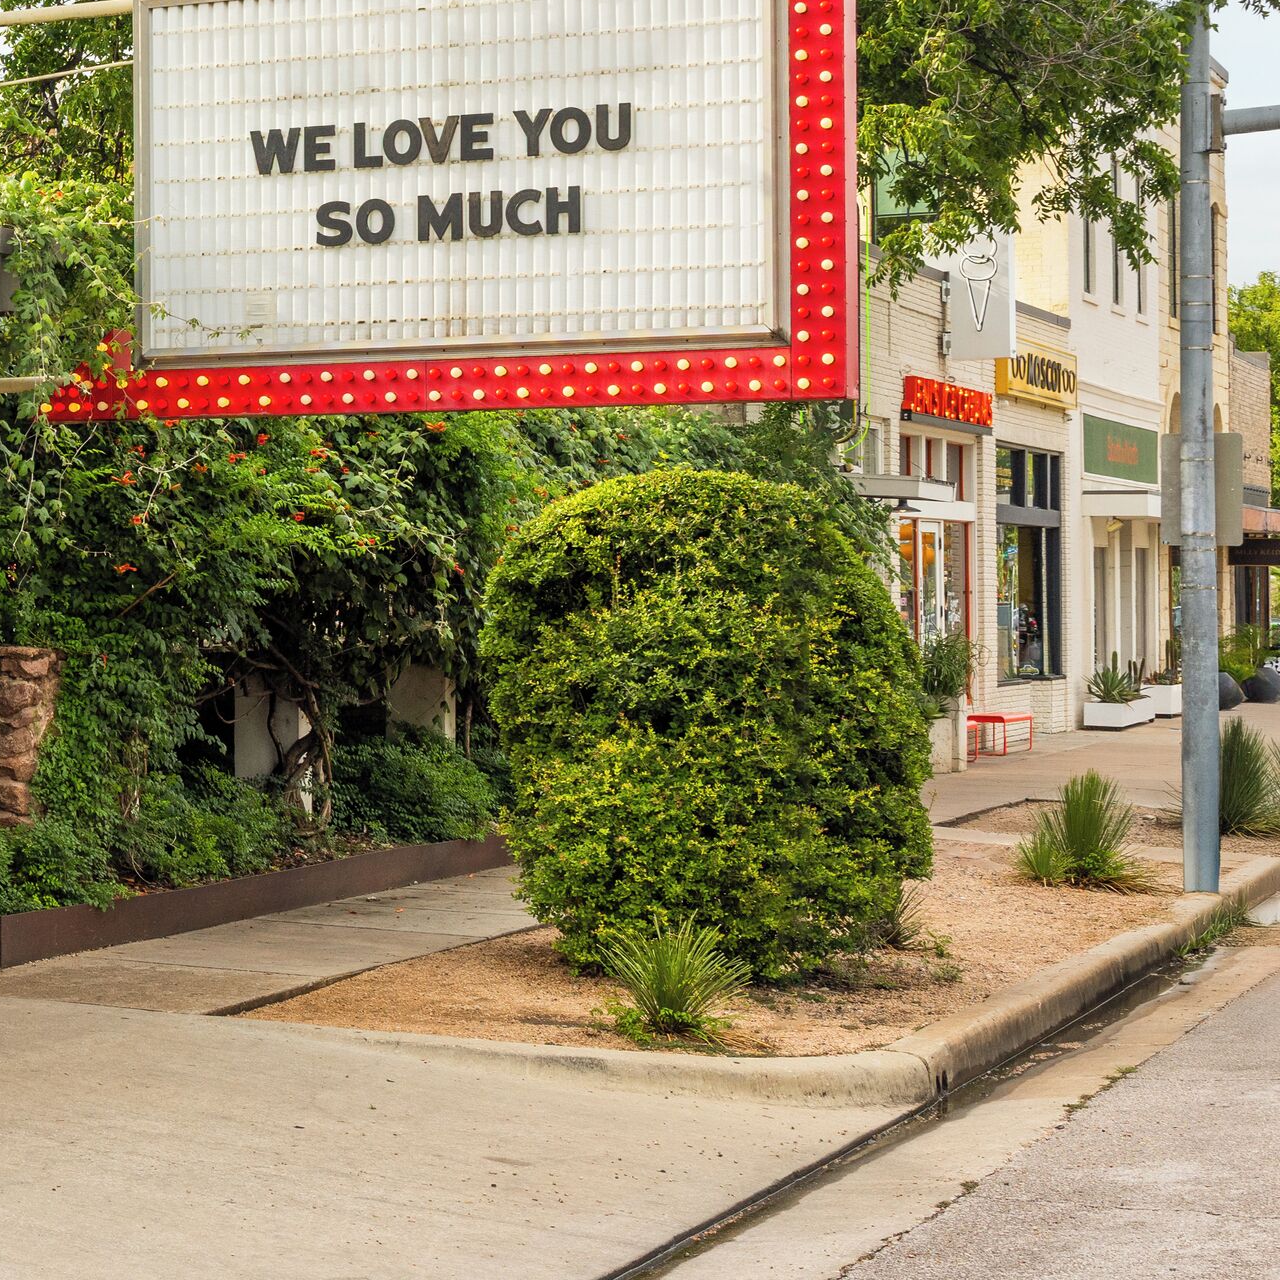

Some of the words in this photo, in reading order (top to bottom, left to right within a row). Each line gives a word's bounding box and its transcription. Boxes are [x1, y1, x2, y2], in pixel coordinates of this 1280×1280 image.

[250, 124, 336, 175] WE
[353, 112, 494, 169] LOVE
[513, 102, 632, 157] YOU
[315, 197, 394, 248] SO
[416, 184, 581, 243] MUCH
[1026, 352, 1062, 394] MOSCOT
